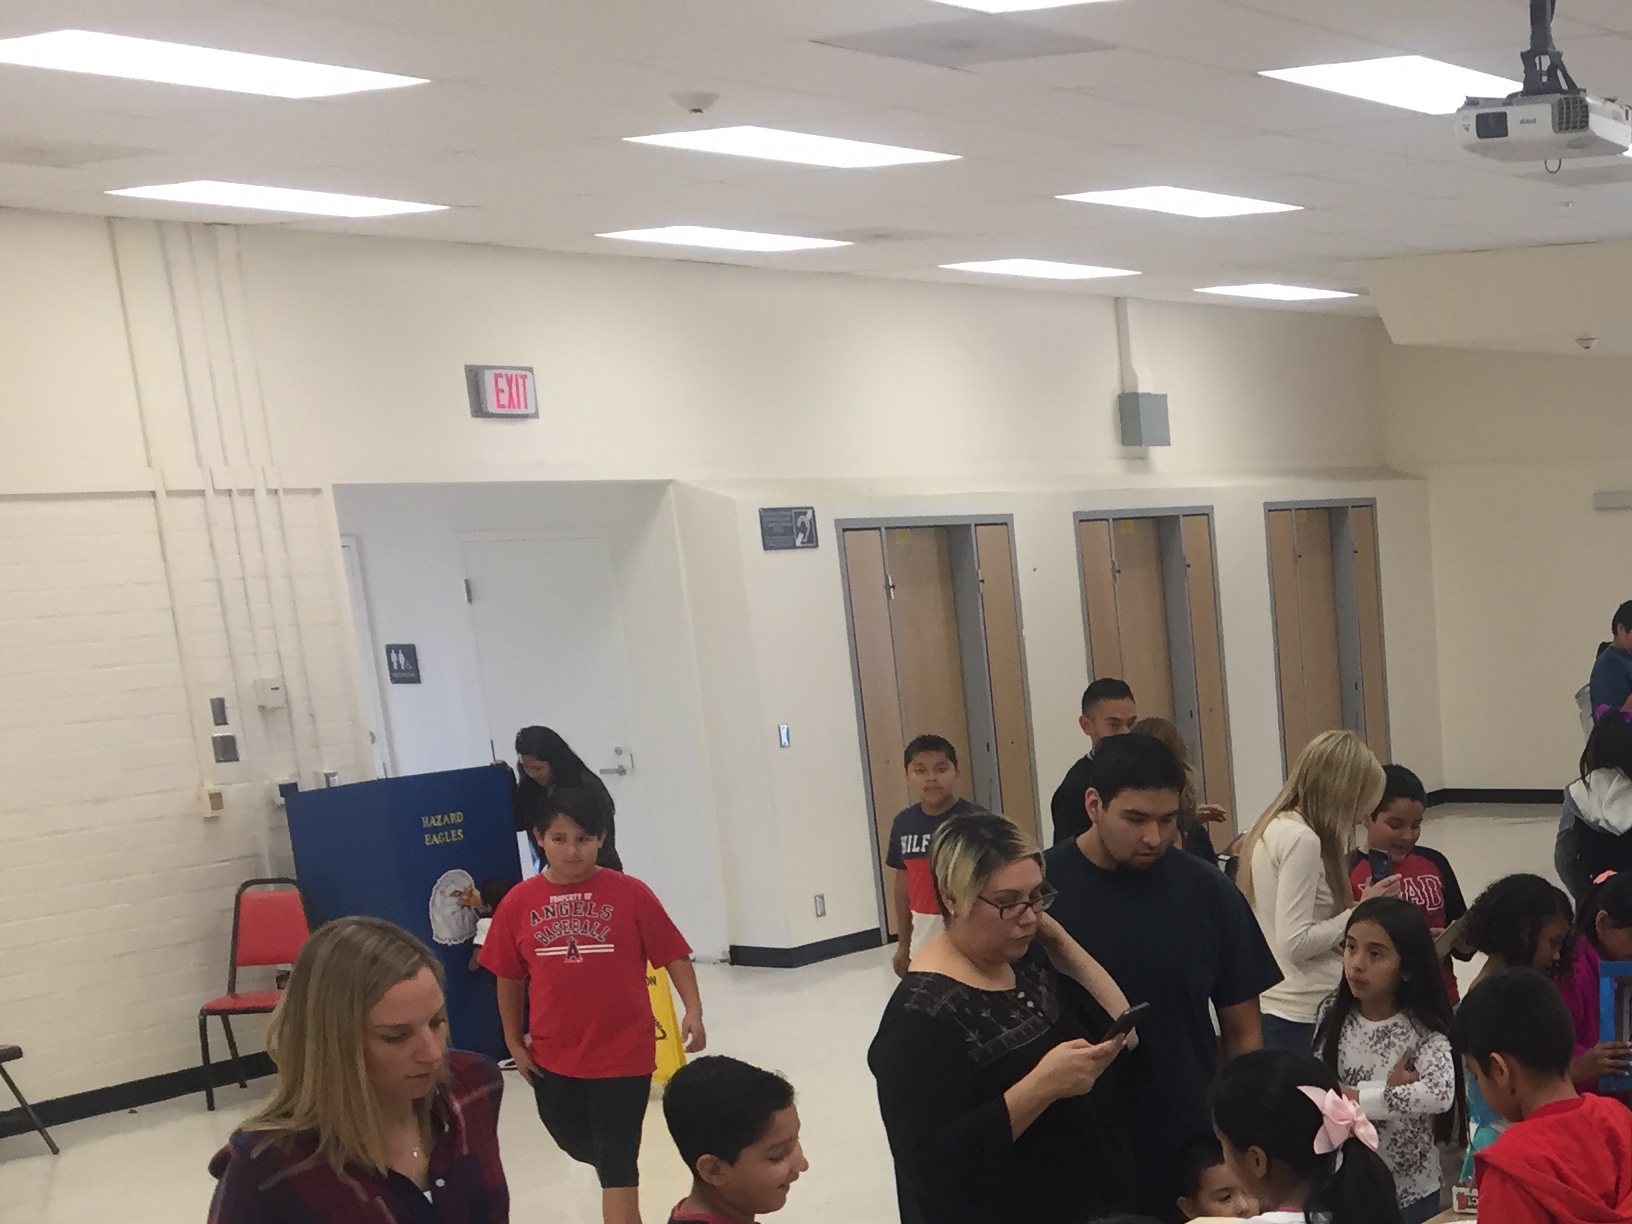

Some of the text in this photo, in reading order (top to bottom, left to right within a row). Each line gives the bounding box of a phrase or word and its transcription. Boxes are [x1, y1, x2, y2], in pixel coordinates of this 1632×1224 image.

[493, 372, 528, 409] EXIT
[421, 811, 464, 828] HAZARD
[424, 829, 464, 846] EAGLES
[900, 833, 931, 855] HILF
[530, 900, 614, 926] ANGELS
[534, 919, 610, 946] BASEBALL
